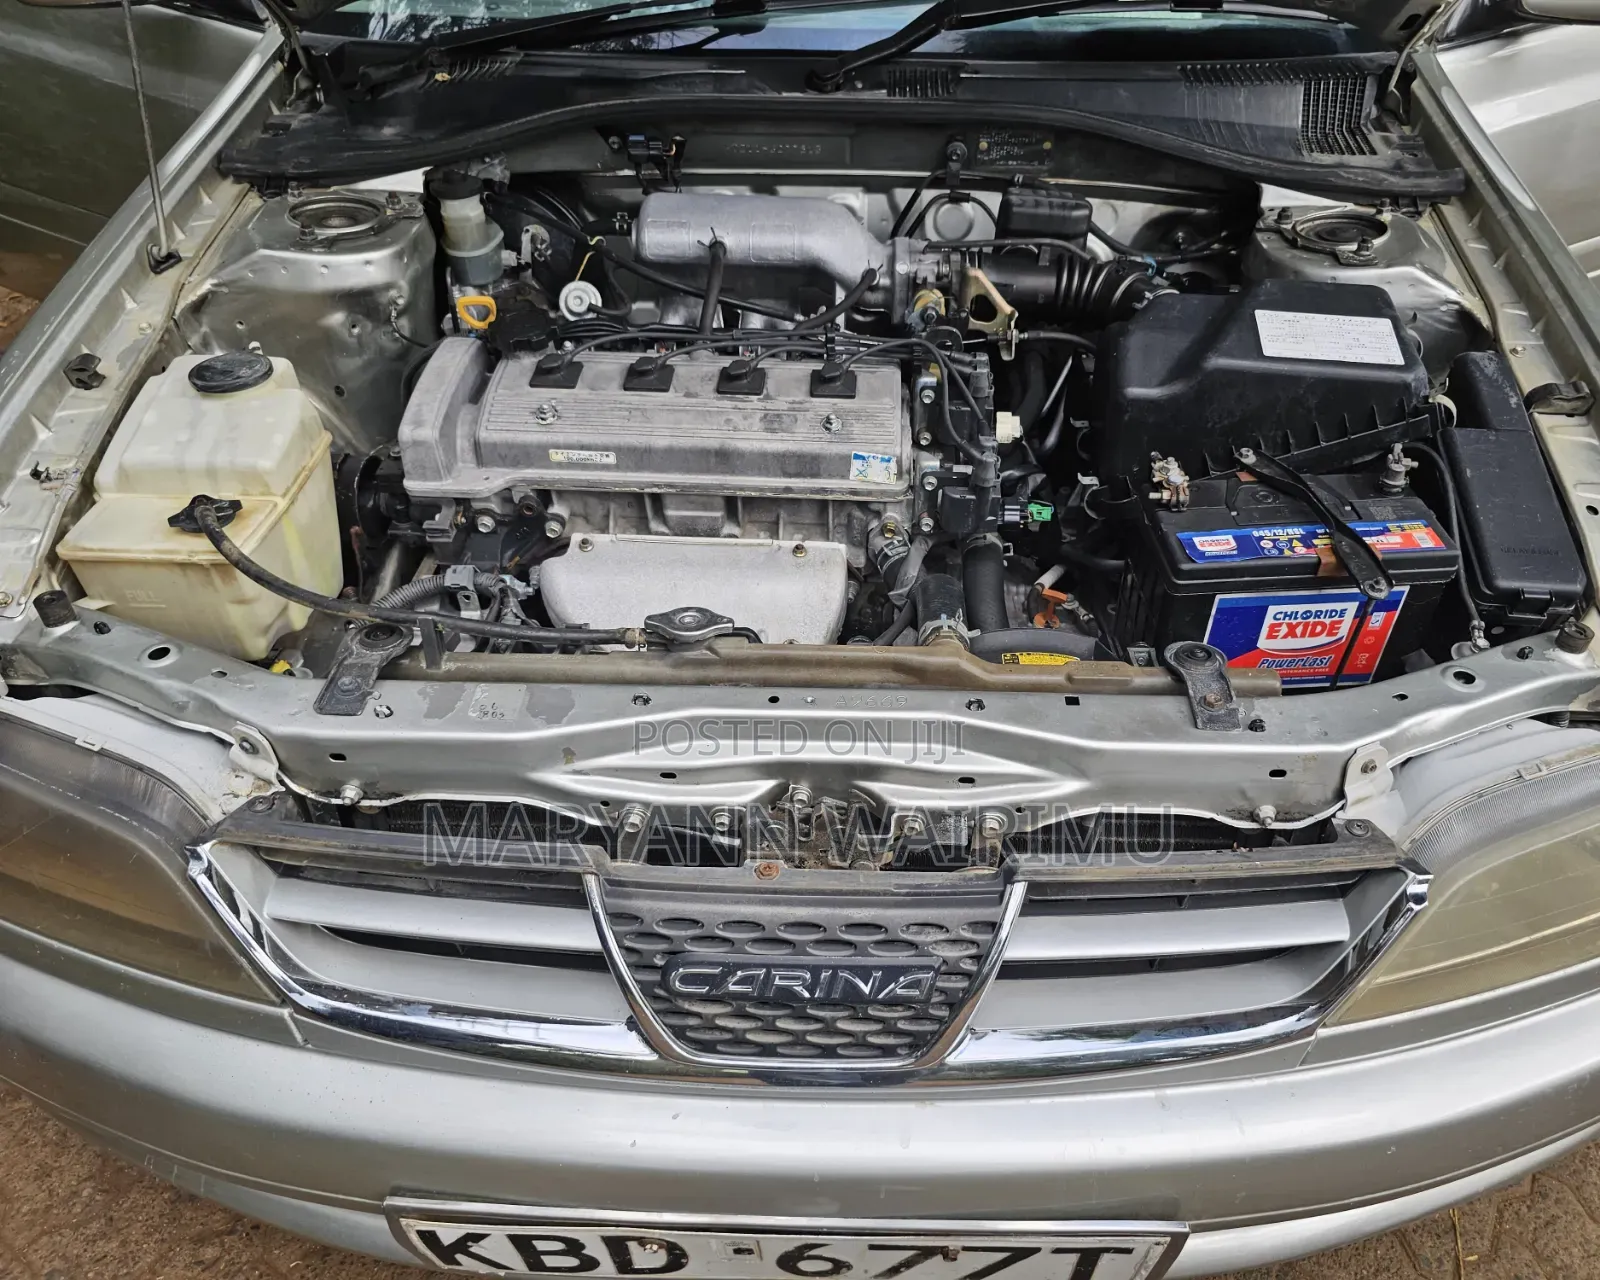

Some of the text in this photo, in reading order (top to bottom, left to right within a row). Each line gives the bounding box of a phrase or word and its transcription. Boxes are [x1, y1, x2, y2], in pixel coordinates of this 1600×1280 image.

[1272, 608, 1348, 621] CHLORIDE
[1265, 619, 1345, 640] EXIDE
[669, 966, 934, 999] CARINA
[416, 1230, 1134, 1280] KBD 677T
